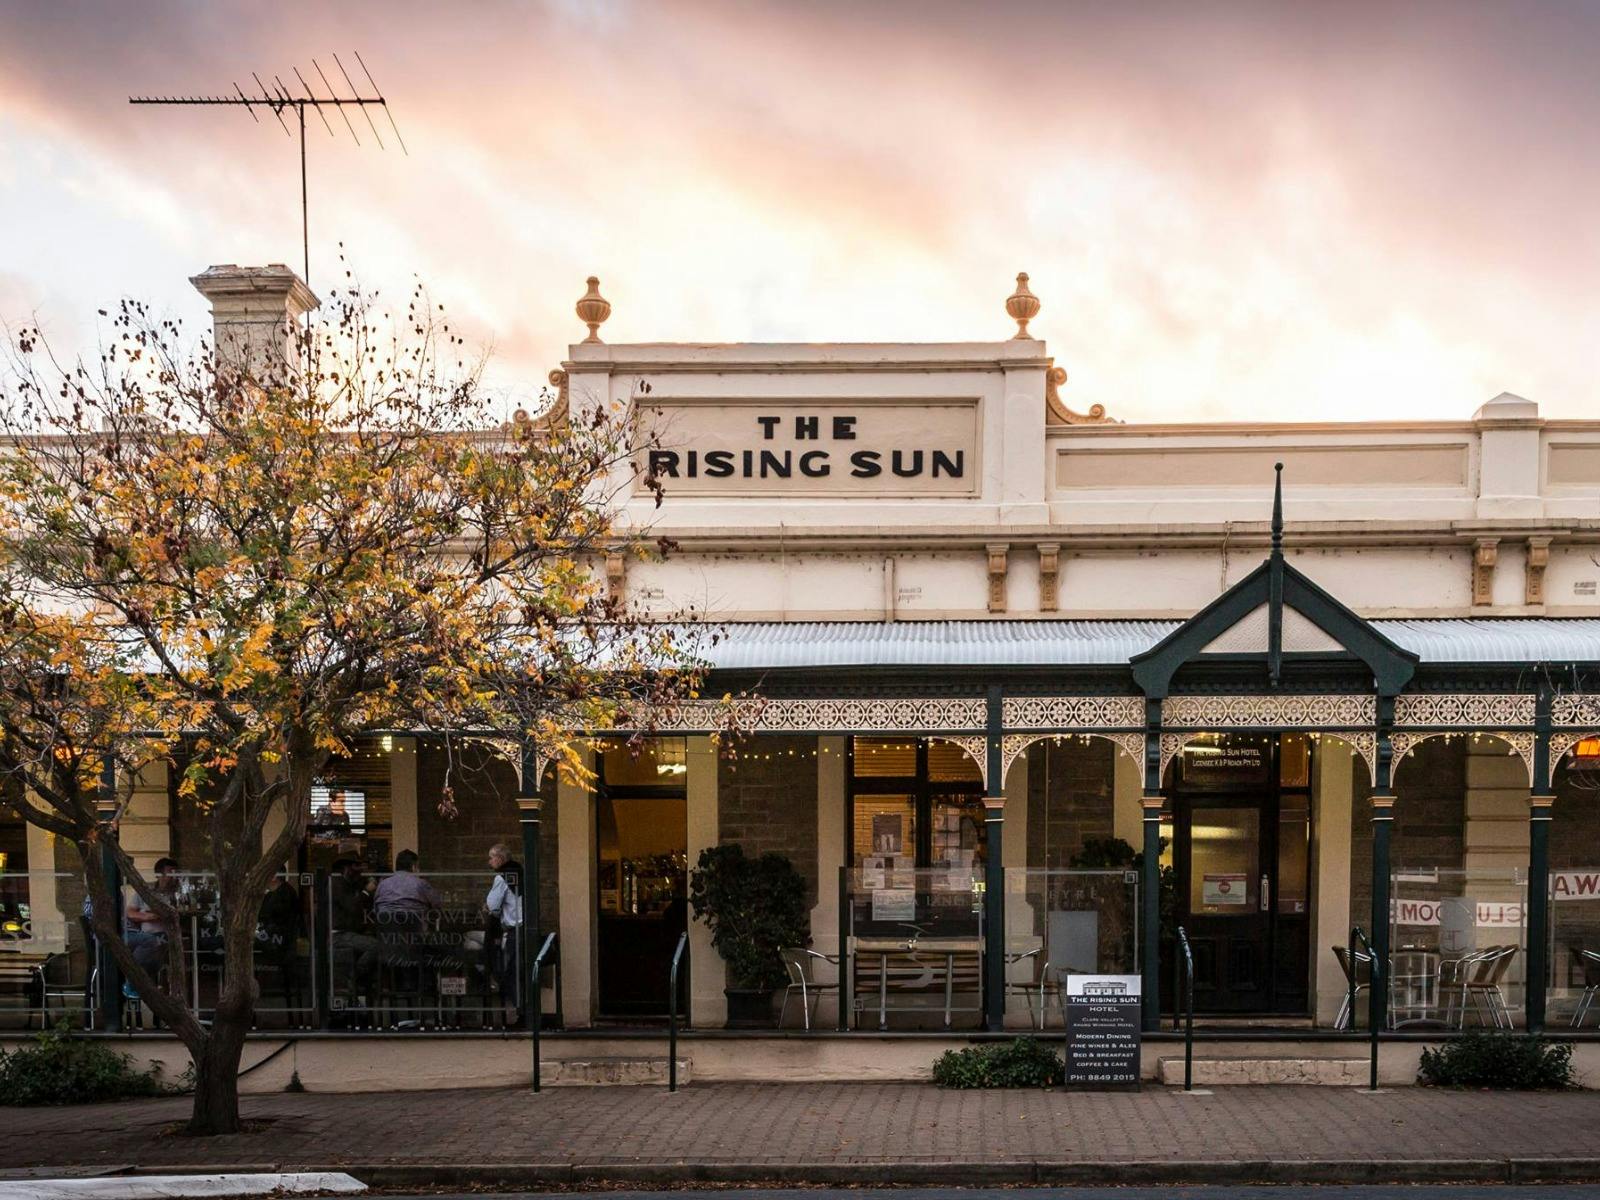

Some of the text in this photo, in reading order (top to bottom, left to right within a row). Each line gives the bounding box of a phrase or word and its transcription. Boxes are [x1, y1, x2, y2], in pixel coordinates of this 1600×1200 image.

[757, 416, 857, 440] THE
[650, 450, 964, 478] RISING SUN
[1240, 748, 1260, 756] HOTEL
[363, 909, 487, 925] KOONOWLA
